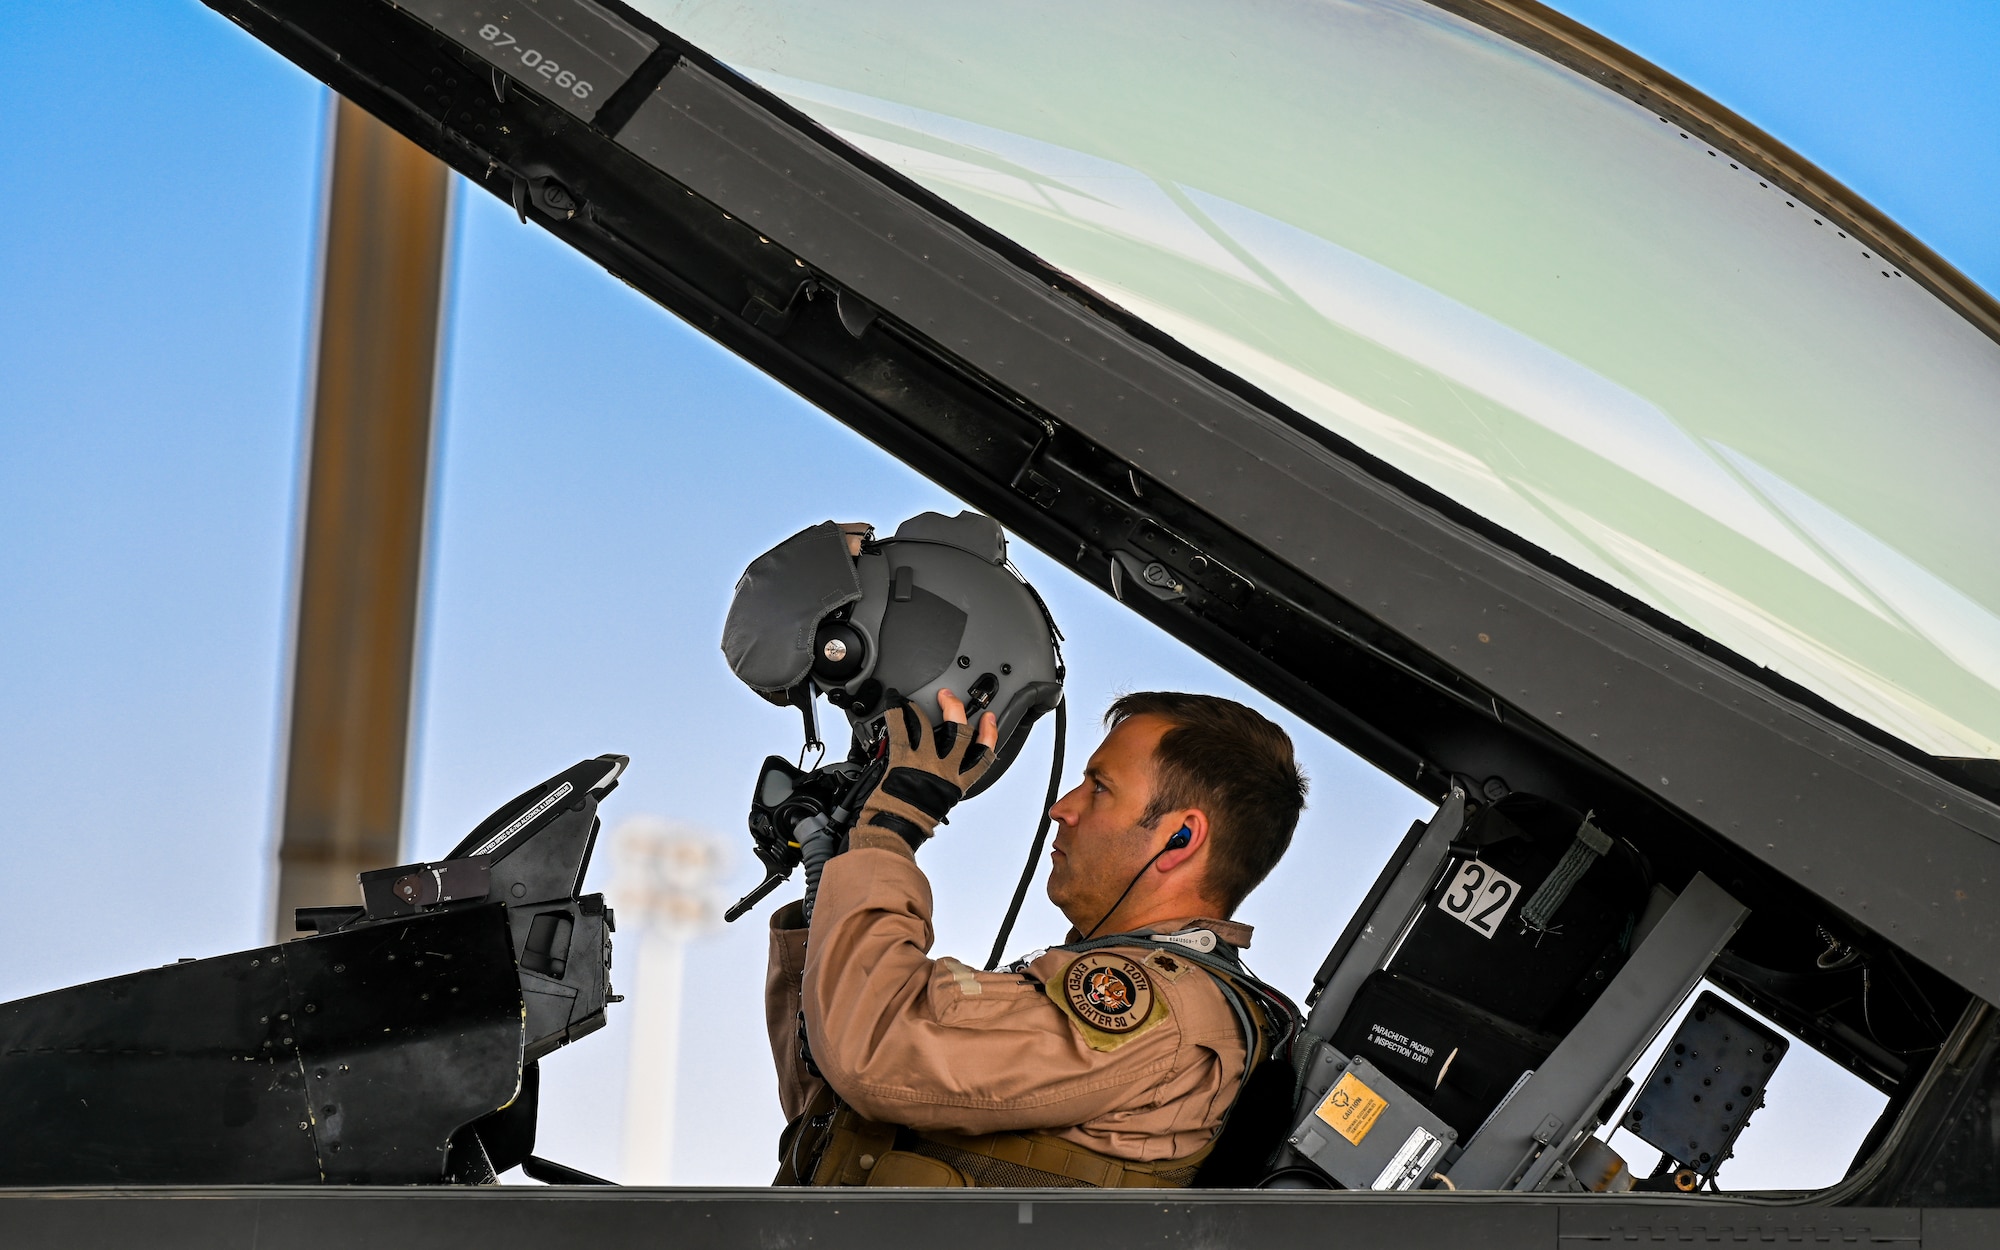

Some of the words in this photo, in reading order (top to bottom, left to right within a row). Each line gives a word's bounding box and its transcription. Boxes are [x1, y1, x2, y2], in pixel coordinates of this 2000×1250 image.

[478, 23, 594, 99] 87-0266
[1446, 864, 1512, 932] 32
[1069, 962, 1089, 991] EXPED
[1122, 962, 1148, 991] 120TH
[1072, 994, 1112, 1027] FIGHTER
[1114, 1017, 1128, 1028] SQ
[1371, 1023, 1409, 1046] PARACHUTE
[1373, 1035, 1412, 1058] INSPECTION
[1411, 1052, 1429, 1065] DATA
[1342, 1096, 1363, 1120] CAUTION
